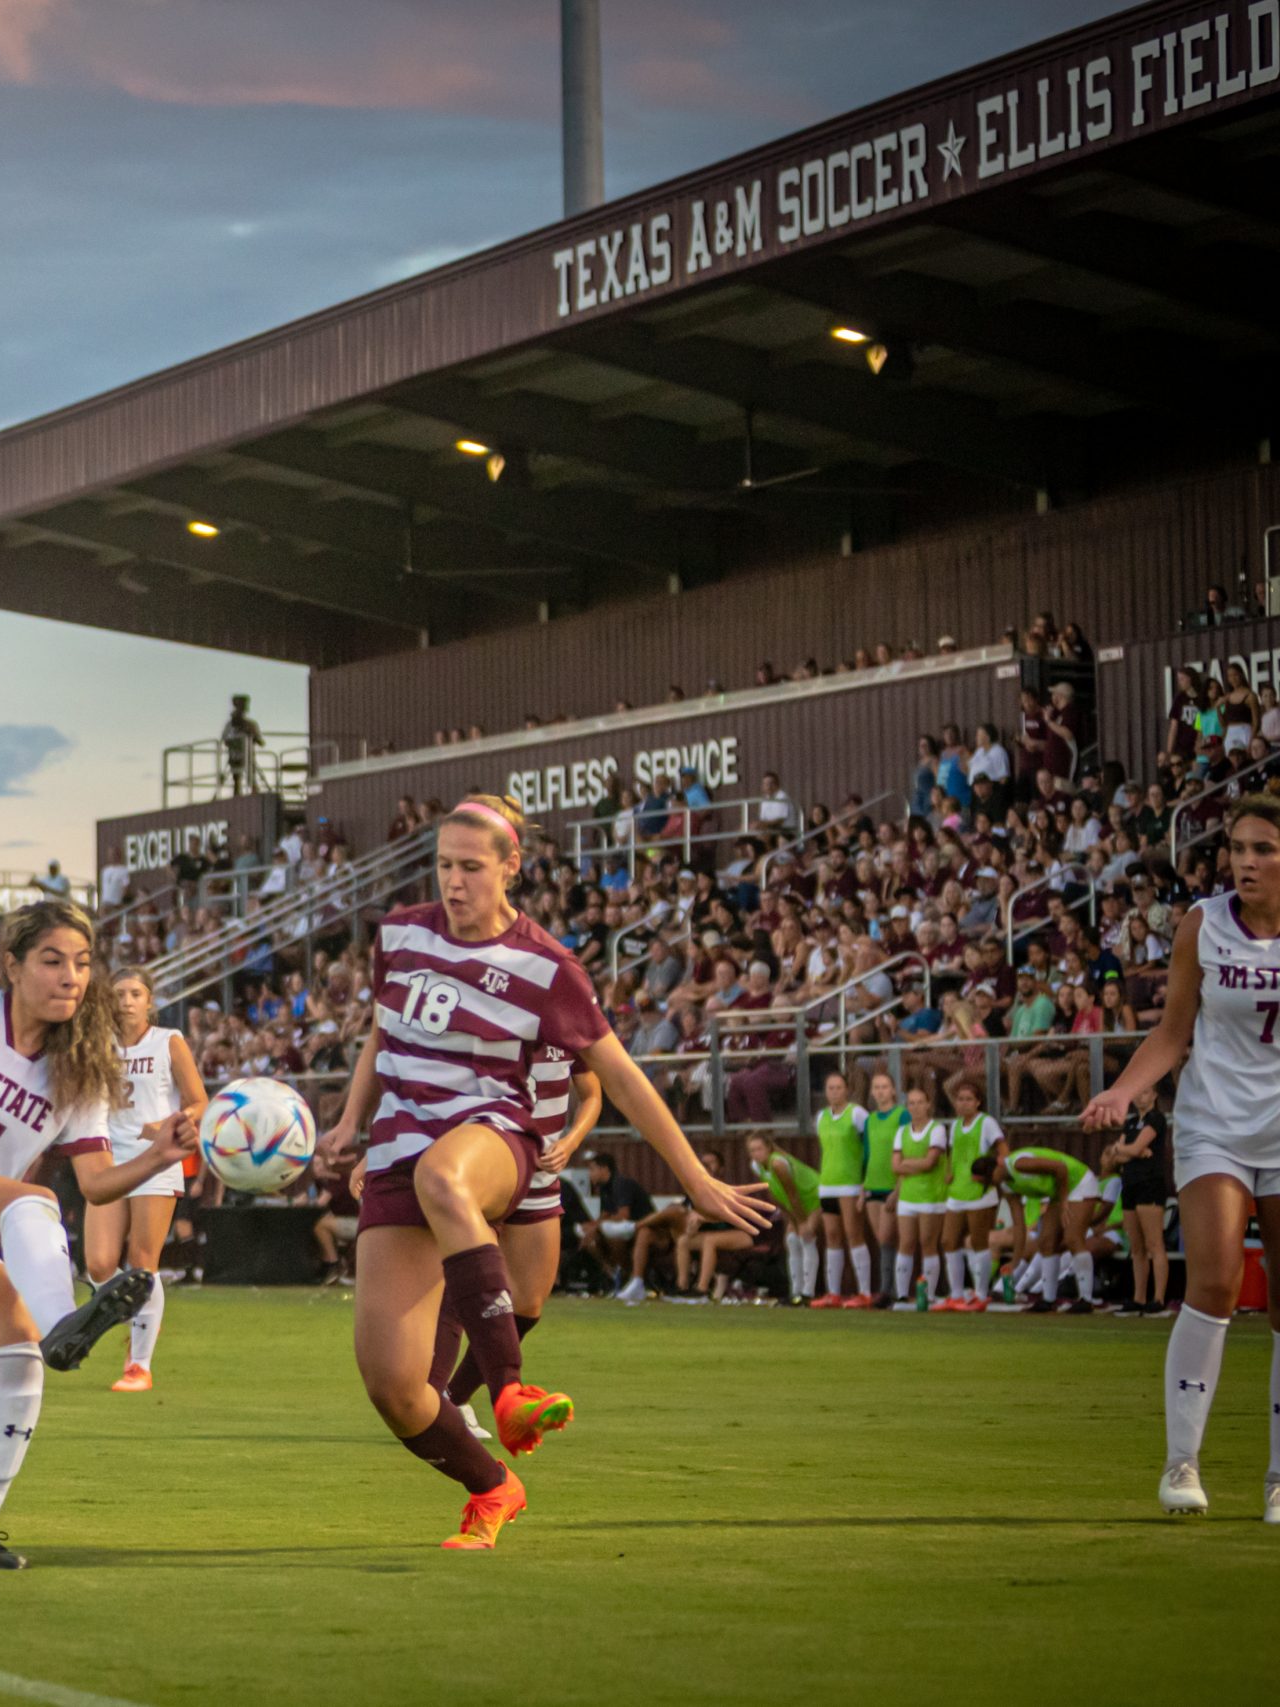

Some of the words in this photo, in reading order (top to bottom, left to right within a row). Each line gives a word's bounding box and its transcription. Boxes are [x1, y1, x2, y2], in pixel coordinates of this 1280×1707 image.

[553, 213, 671, 317] TEXAS
[686, 179, 763, 274] A&M
[778, 122, 929, 244] SOCCER
[976, 56, 1113, 180] ELLIS
[1131, 0, 1280, 127] FIELD
[509, 757, 618, 815] SELFLESS
[634, 736, 739, 796] SERVICE
[1218, 965, 1248, 989] NM
[400, 973, 462, 1036] 18
[1256, 1001, 1279, 1044] 7
[121, 1056, 154, 1074] TATE
